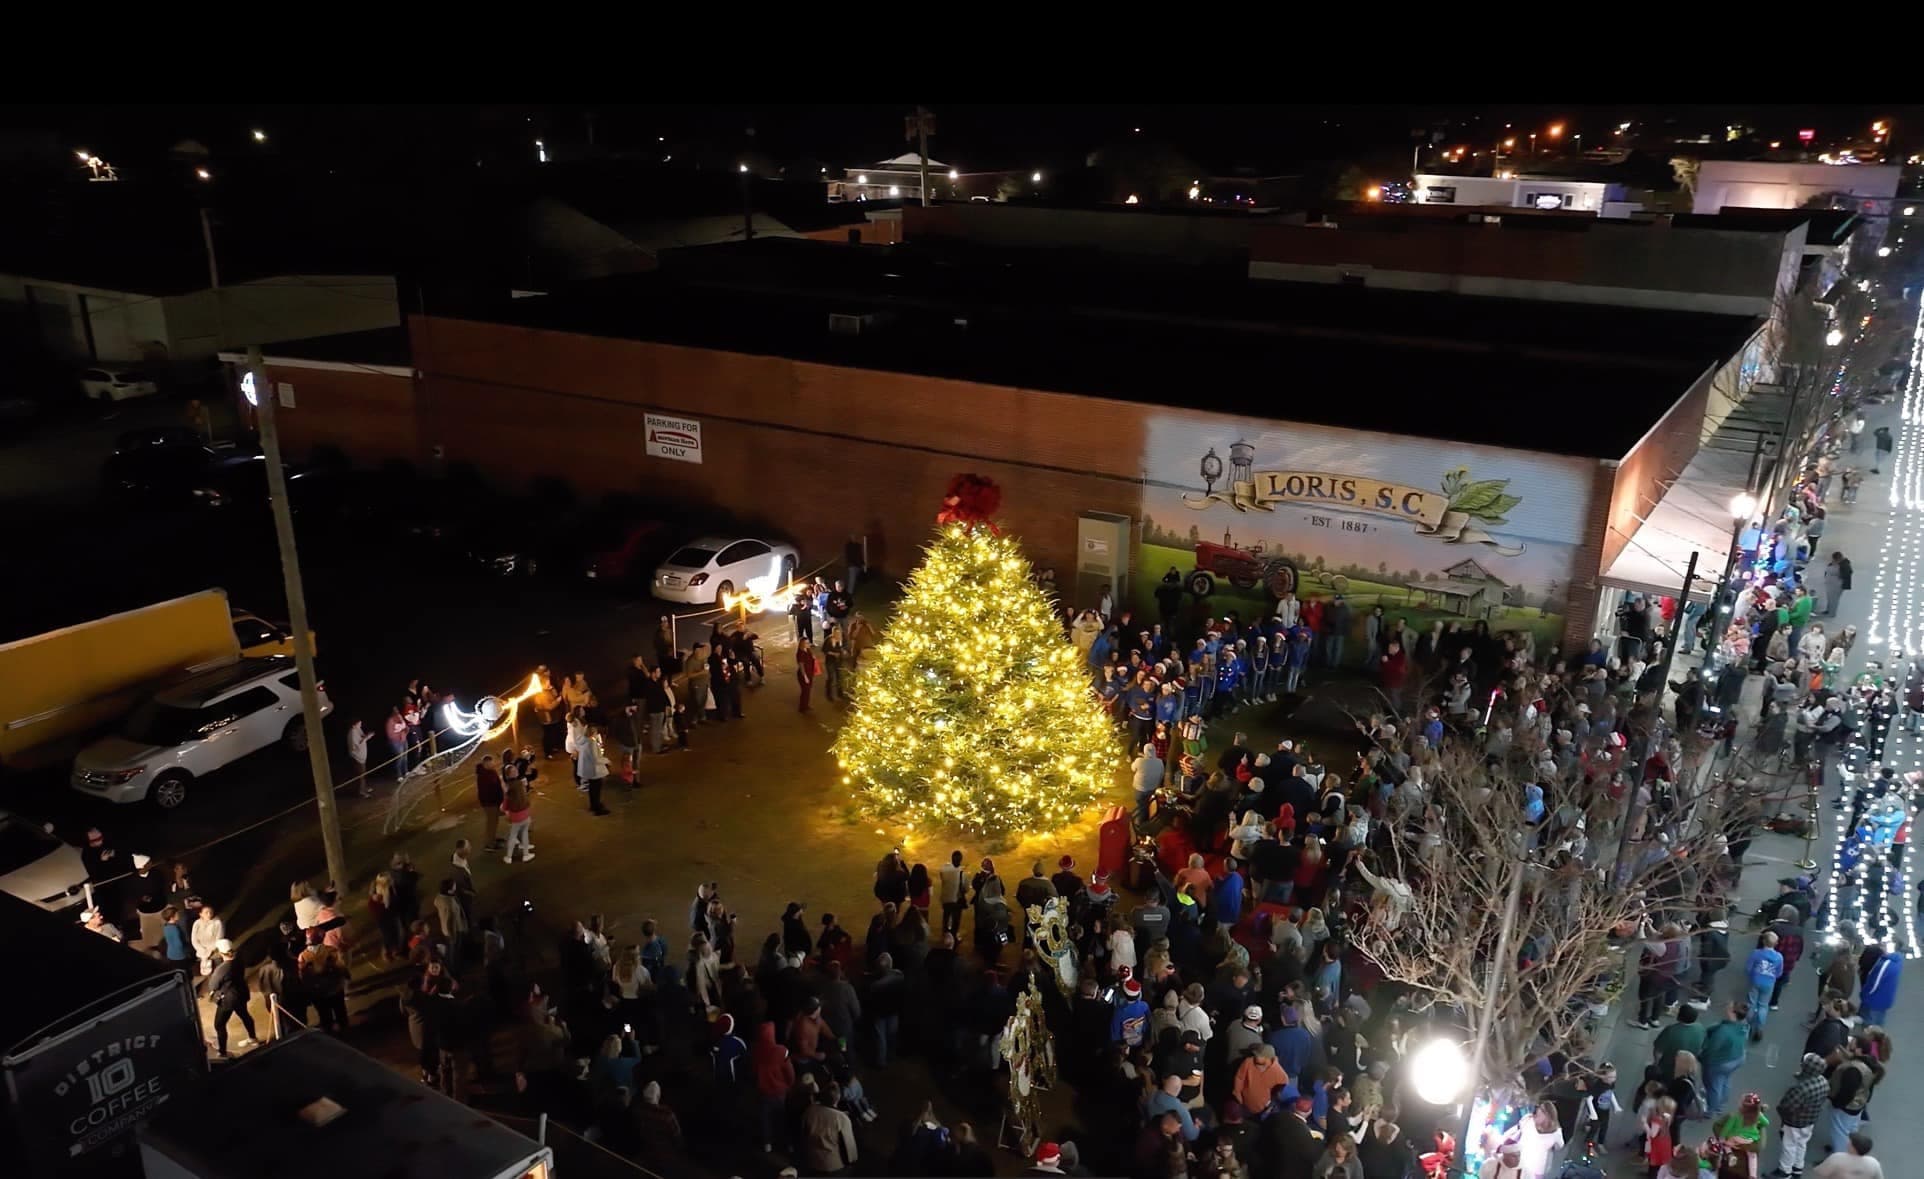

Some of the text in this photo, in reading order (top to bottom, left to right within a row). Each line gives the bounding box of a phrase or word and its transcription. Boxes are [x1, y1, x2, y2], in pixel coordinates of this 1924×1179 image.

[647, 417, 698, 433] PARKING FOR
[661, 446, 686, 457] ONLY
[1375, 487, 1426, 518] S.C.
[1341, 519, 1369, 534] 1887
[55, 1034, 161, 1097] DISTRICT
[69, 1075, 161, 1135] COFFEE
